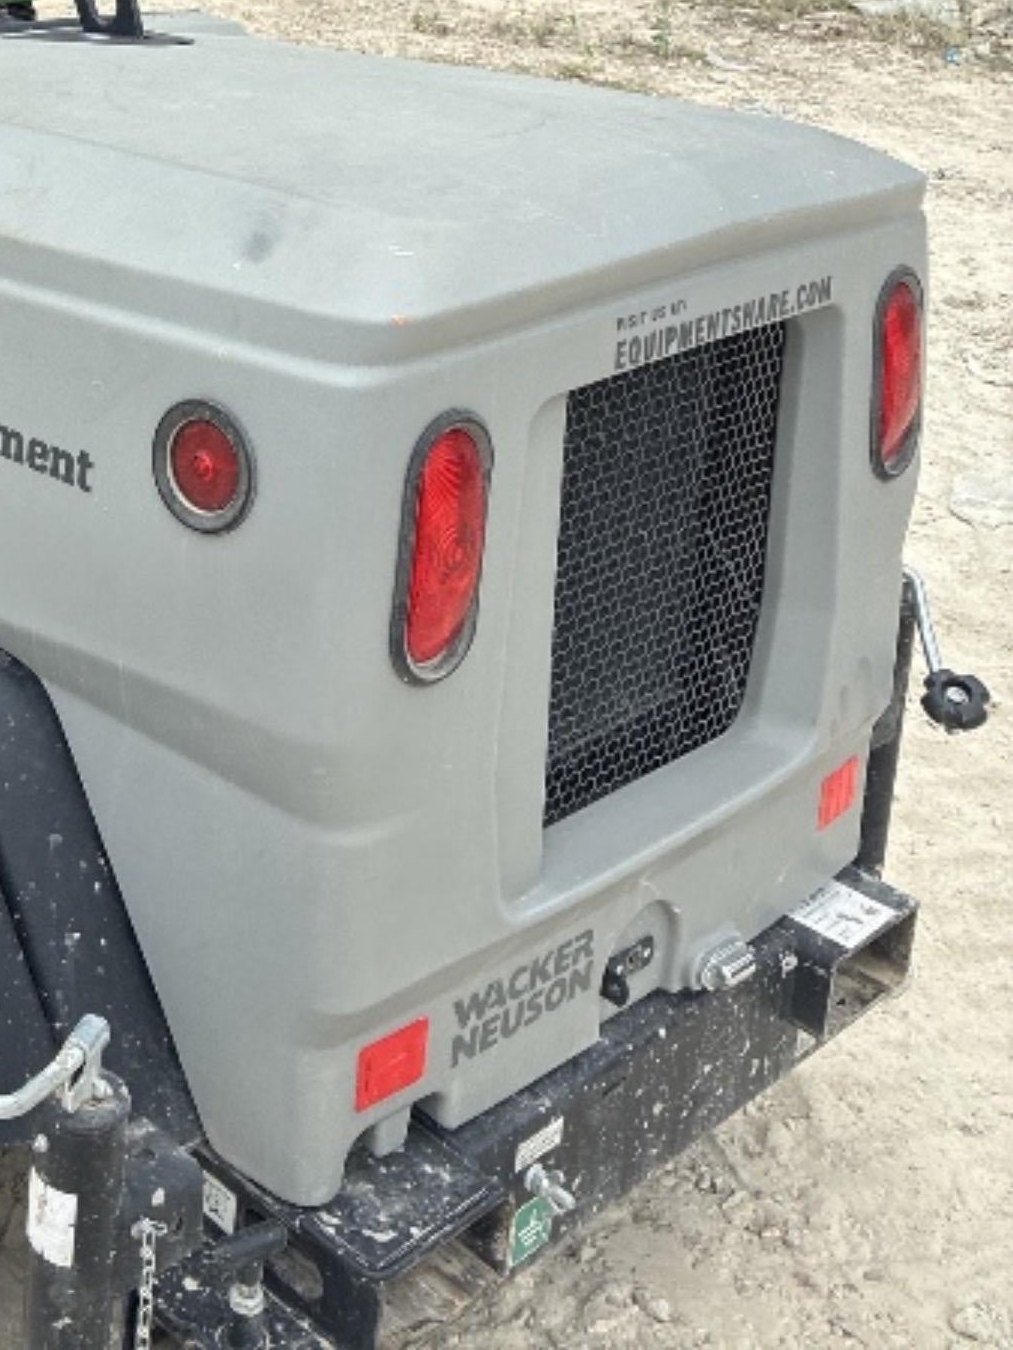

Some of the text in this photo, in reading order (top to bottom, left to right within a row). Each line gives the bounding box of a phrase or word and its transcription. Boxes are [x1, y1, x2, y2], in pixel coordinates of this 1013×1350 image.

[614, 275, 834, 369] EQUIPMENTSHARE.COM
[450, 959, 594, 1068] NEUSON
[452, 929, 594, 1029] WACKER
